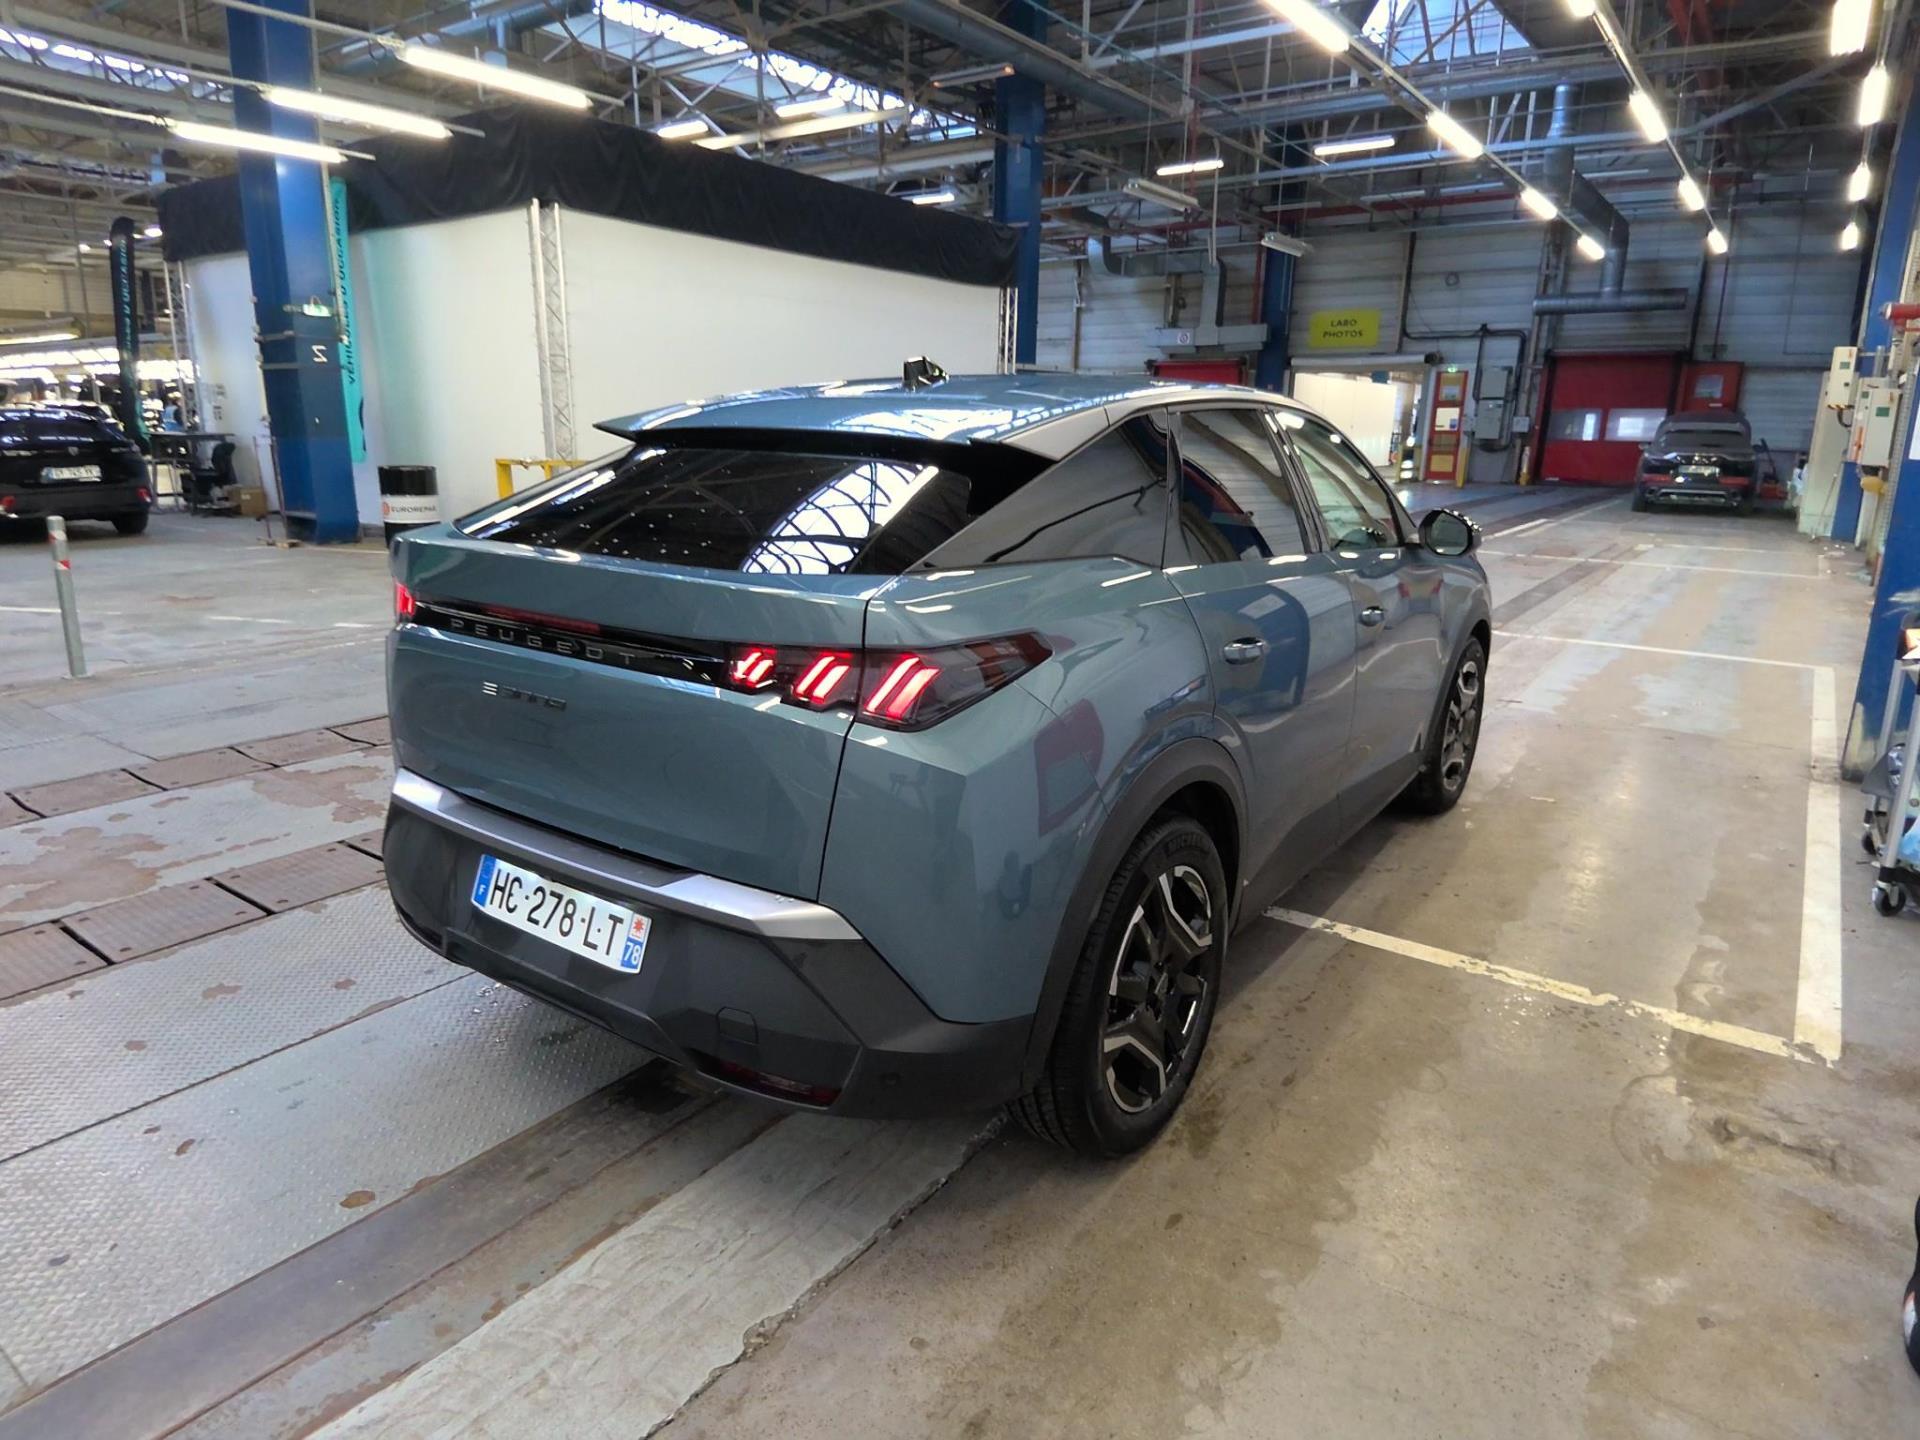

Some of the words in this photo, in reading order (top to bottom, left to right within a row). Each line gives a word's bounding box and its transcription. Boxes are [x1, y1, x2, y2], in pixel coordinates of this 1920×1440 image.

[335, 198, 347, 296] DOCCASION
[1330, 319, 1358, 328] LABO
[1322, 330, 1363, 339] PHOTOS
[450, 617, 635, 666] PEUGEOT
[479, 884, 487, 896] F
[623, 941, 642, 966] 78
